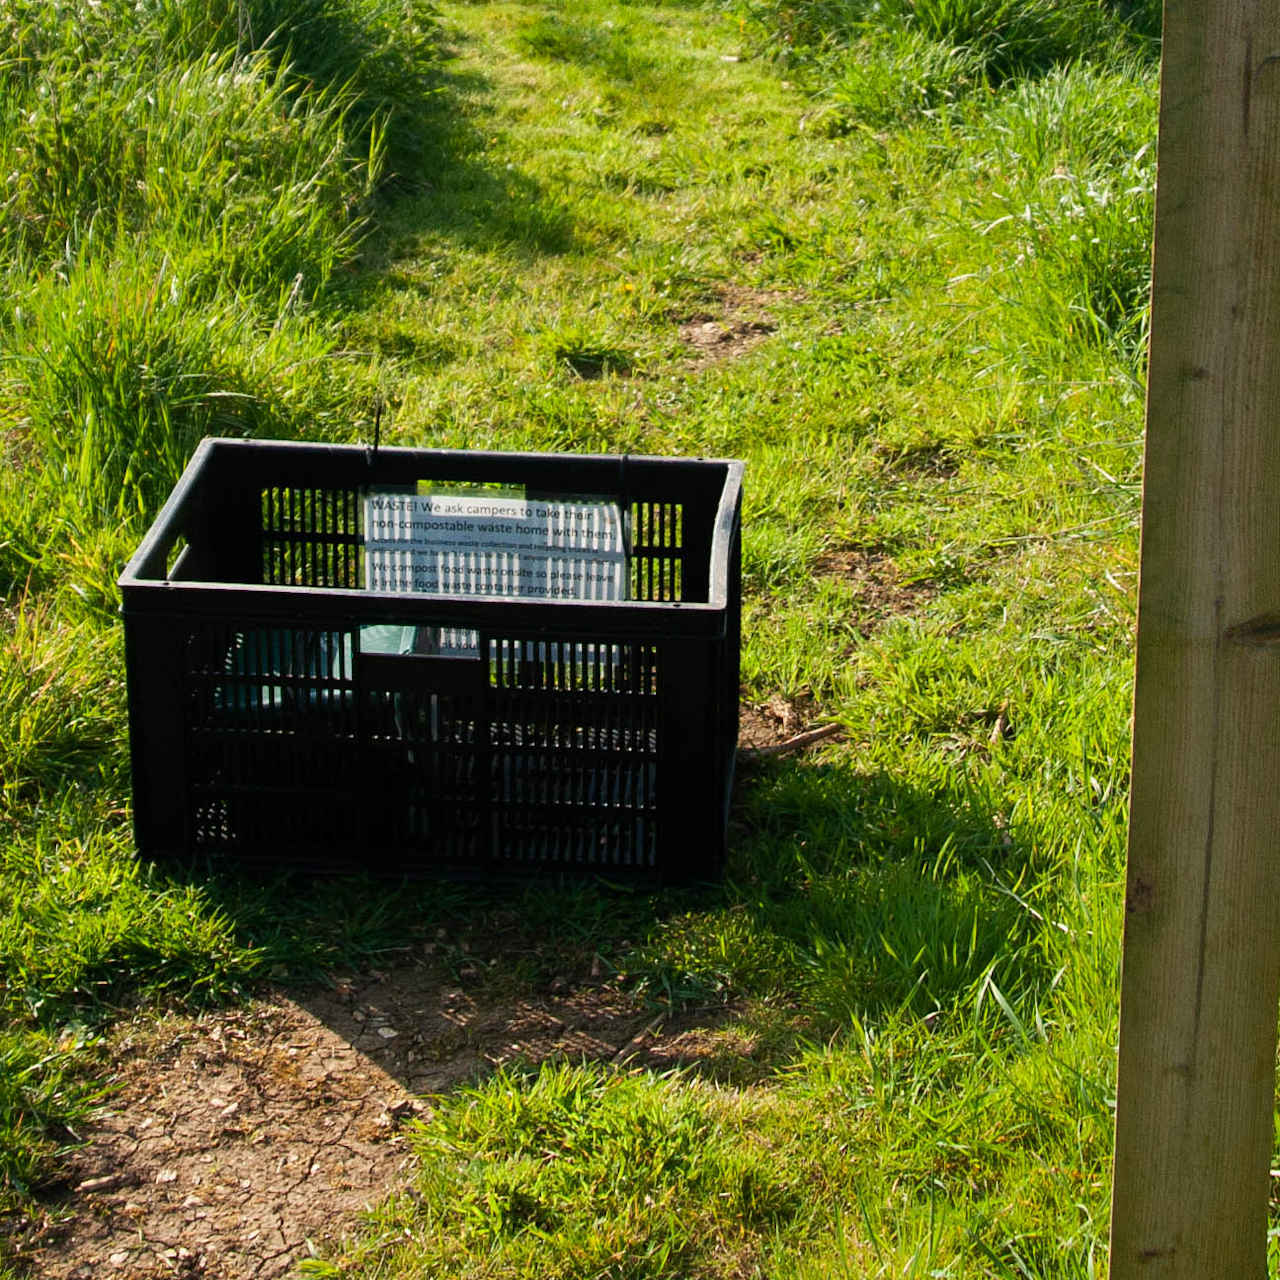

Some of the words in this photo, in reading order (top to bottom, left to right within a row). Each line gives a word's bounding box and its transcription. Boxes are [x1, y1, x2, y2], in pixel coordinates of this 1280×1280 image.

[421, 502, 441, 513] We
[445, 502, 464, 514] ask
[466, 505, 516, 518] campers
[520, 506, 532, 516] to
[536, 507, 560, 518] take
[564, 508, 593, 520] their
[372, 519, 474, 532] non-compostable
[478, 523, 512, 533] waste
[516, 523, 548, 536] home
[552, 526, 578, 537] with
[581, 528, 617, 540] them.
[392, 564, 437, 575] compost
[441, 564, 464, 574] food
[467, 566, 499, 576] waste
[536, 570, 547, 578] so
[551, 569, 584, 582] please
[394, 578, 412, 587] the
[414, 577, 439, 588] food
[442, 580, 472, 590] waste
[475, 581, 525, 592] container
